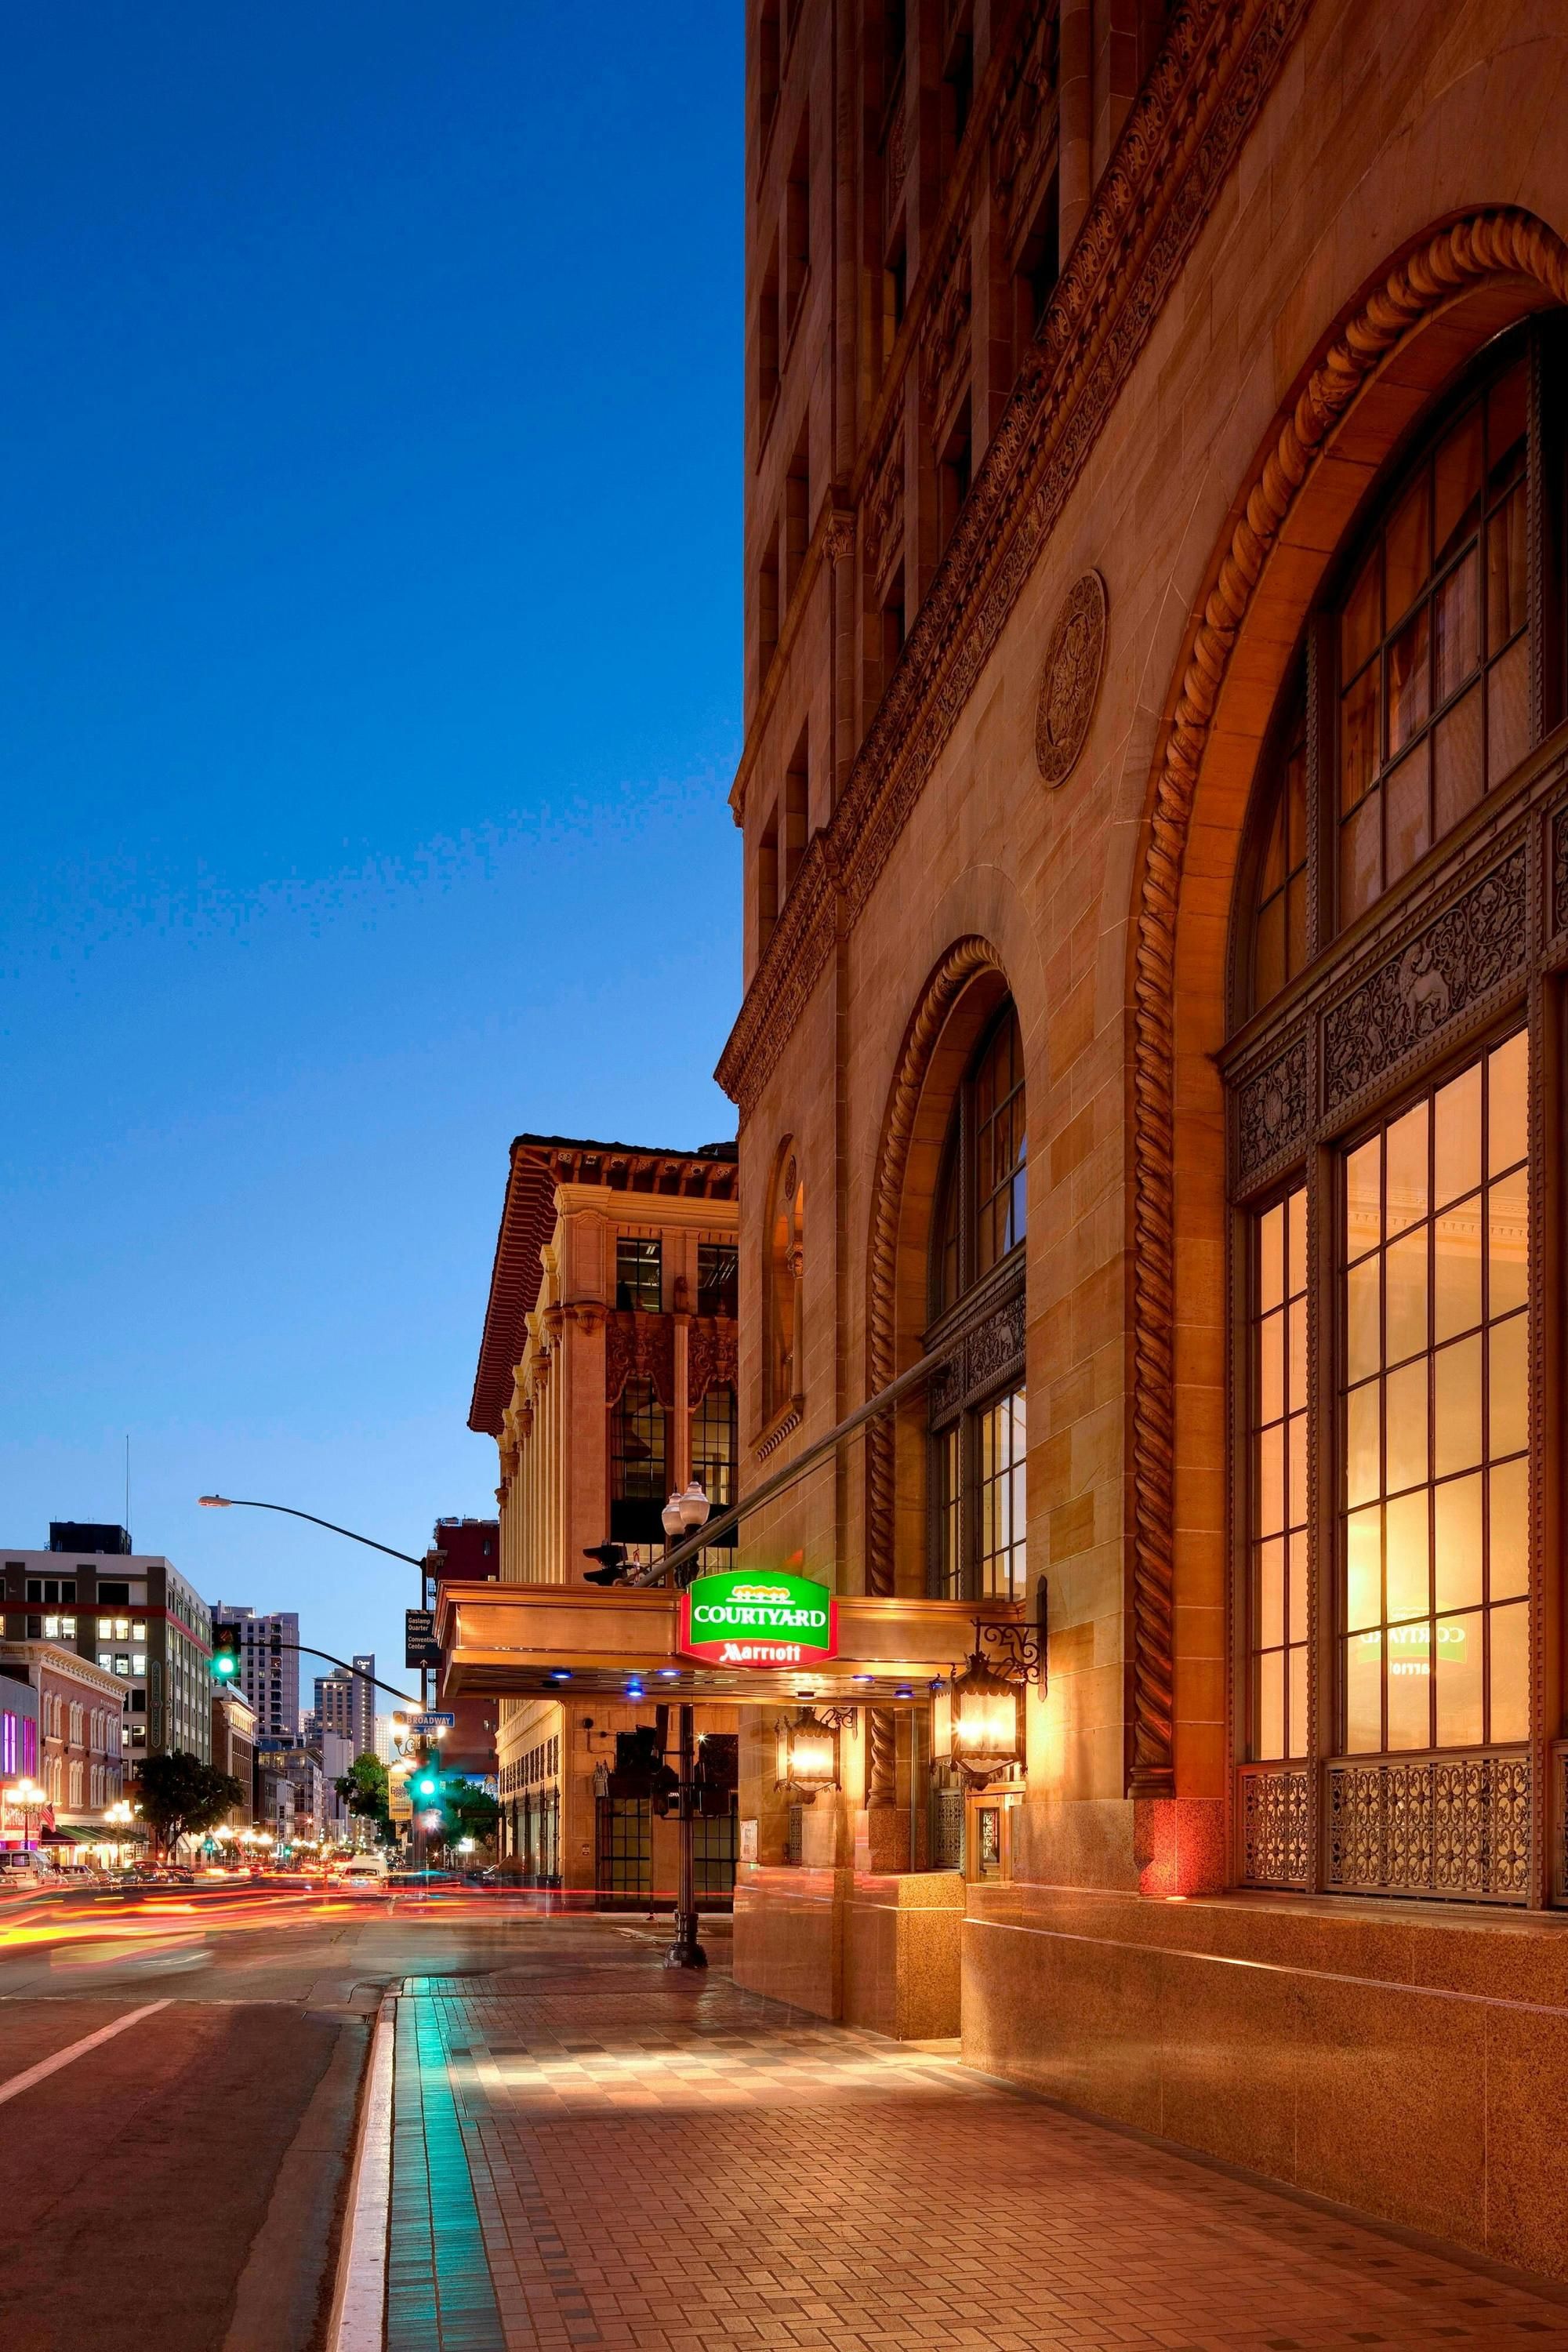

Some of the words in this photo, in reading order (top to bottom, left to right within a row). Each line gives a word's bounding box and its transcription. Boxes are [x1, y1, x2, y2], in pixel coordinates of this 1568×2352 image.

[694, 1605, 826, 1628] COURTYARD
[719, 1642, 801, 1662] Marriott
[407, 1715, 451, 1725] BROADWAY
